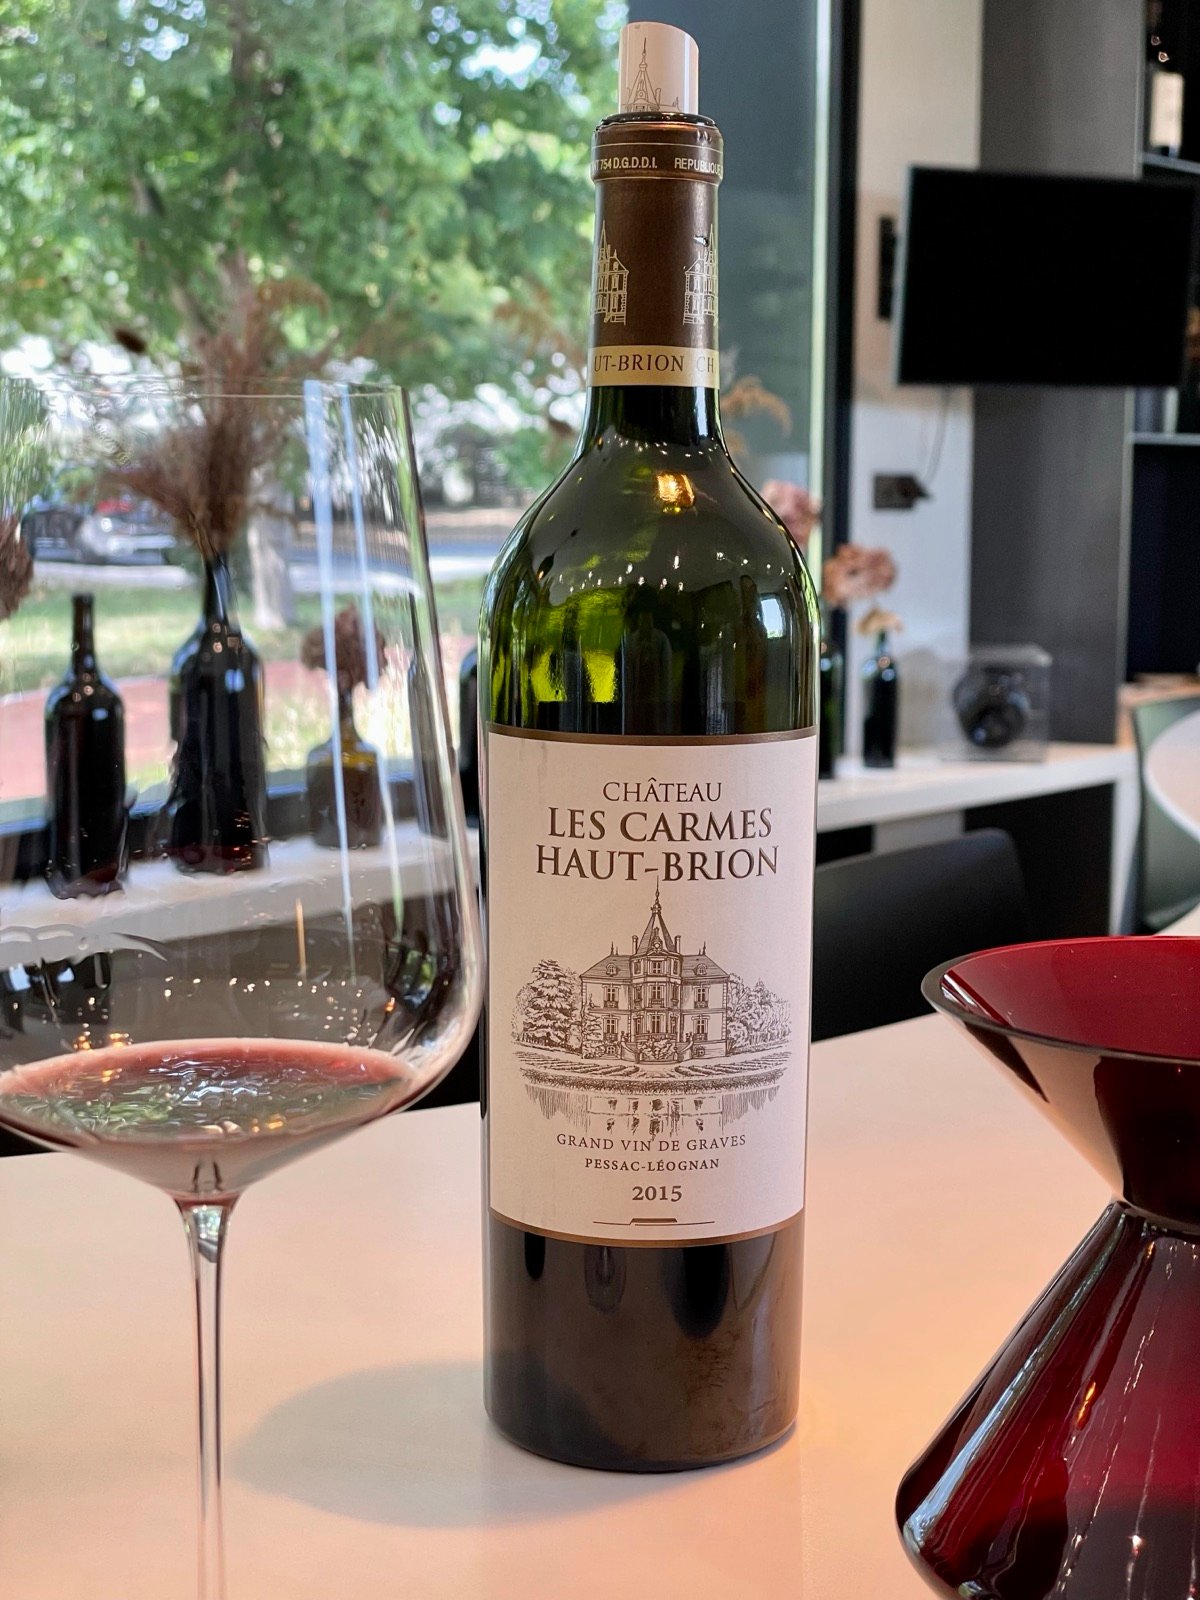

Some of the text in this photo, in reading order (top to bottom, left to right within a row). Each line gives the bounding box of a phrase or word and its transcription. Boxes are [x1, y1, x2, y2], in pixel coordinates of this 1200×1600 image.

[600, 158, 612, 170] 754
[613, 156, 658, 169] D.G.D.D.I.
[674, 157, 722, 176] REPUBLIQUE
[594, 354, 684, 373] UT-BRION
[602, 777, 722, 803] CHÂTEAU
[548, 806, 773, 842] LES CARMES
[536, 844, 779, 881] HAUT-BRION
[556, 1133, 747, 1152] GRAND VIN DE GRAVES
[585, 1158, 720, 1172] PESSAC-LÉOGNAN
[631, 1185, 683, 1202] 2015
